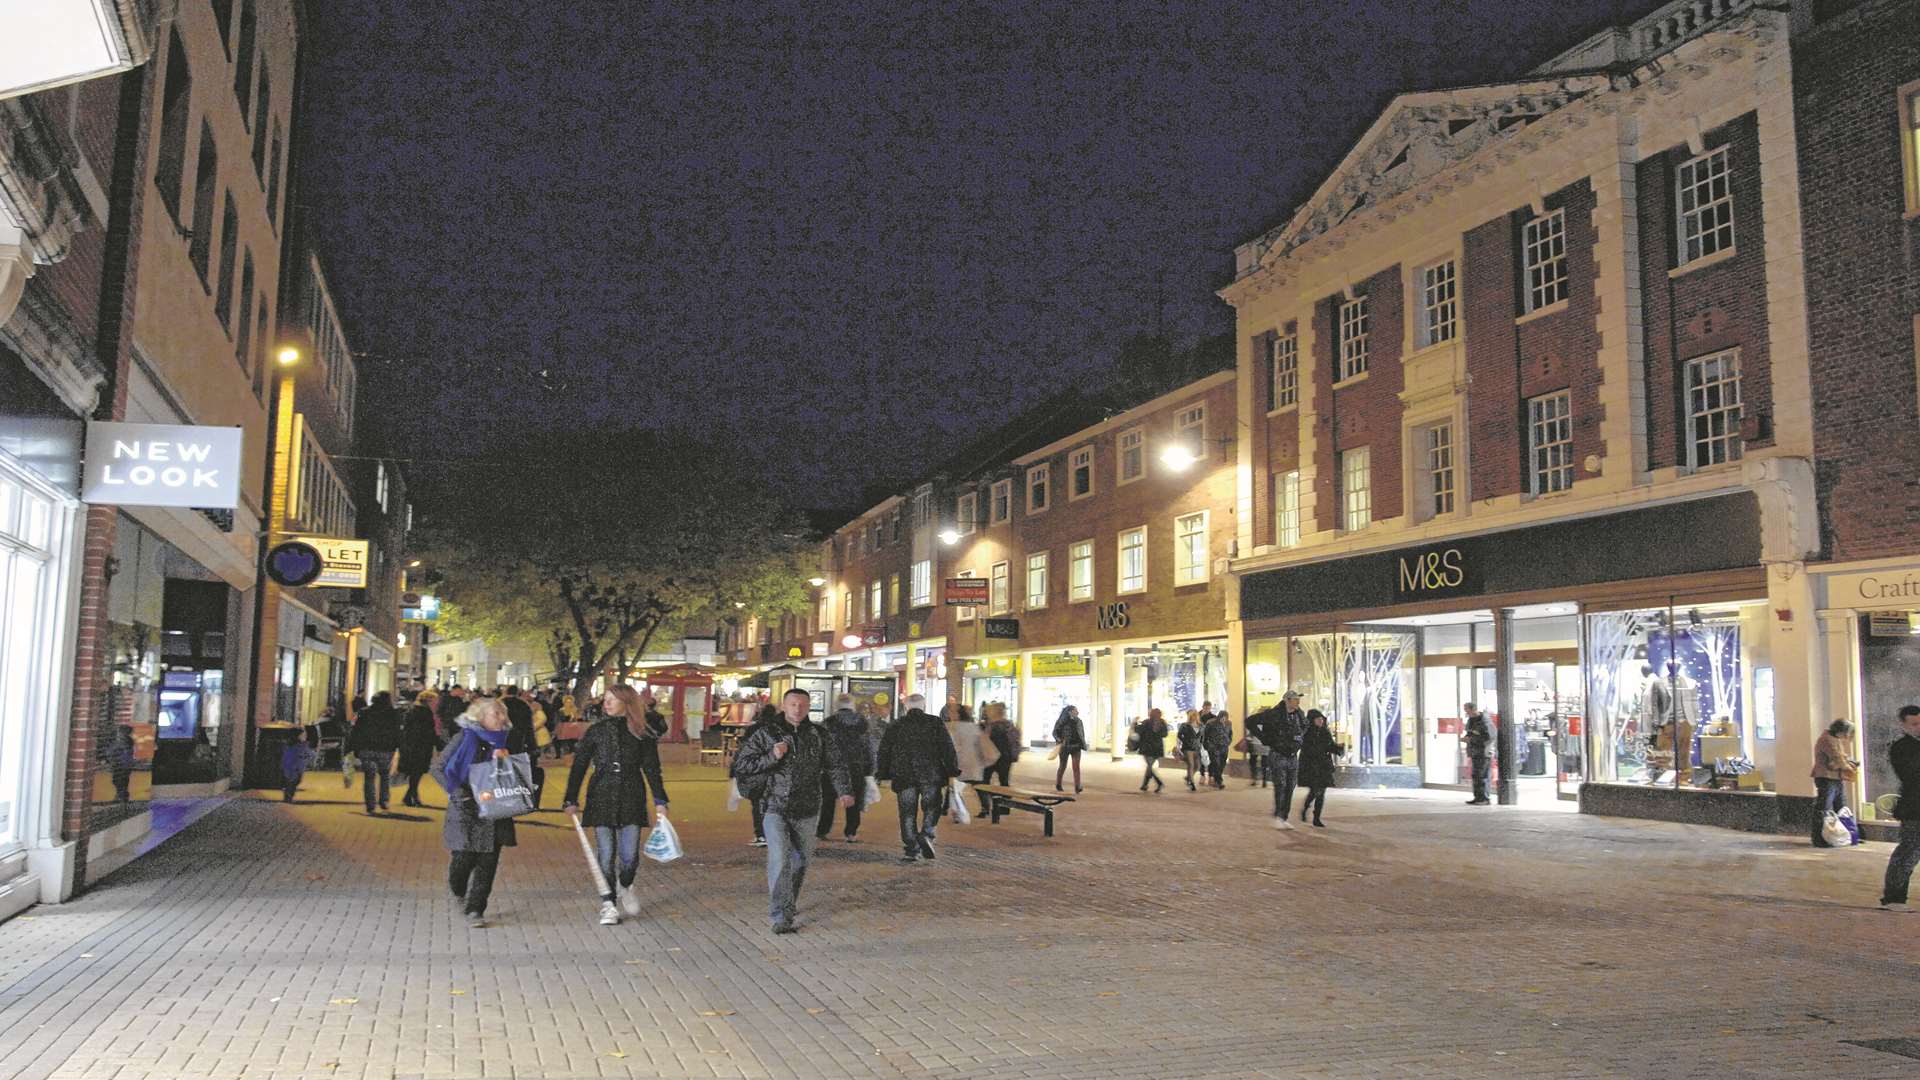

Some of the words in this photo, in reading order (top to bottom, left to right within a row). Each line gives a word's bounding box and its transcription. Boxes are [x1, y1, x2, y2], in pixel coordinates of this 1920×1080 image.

[114, 440, 212, 462] NEW
[103, 464, 219, 488] LOOK
[328, 549, 362, 560] LET
[1400, 549, 1463, 592] M&S
[1097, 602, 1130, 630] M&S
